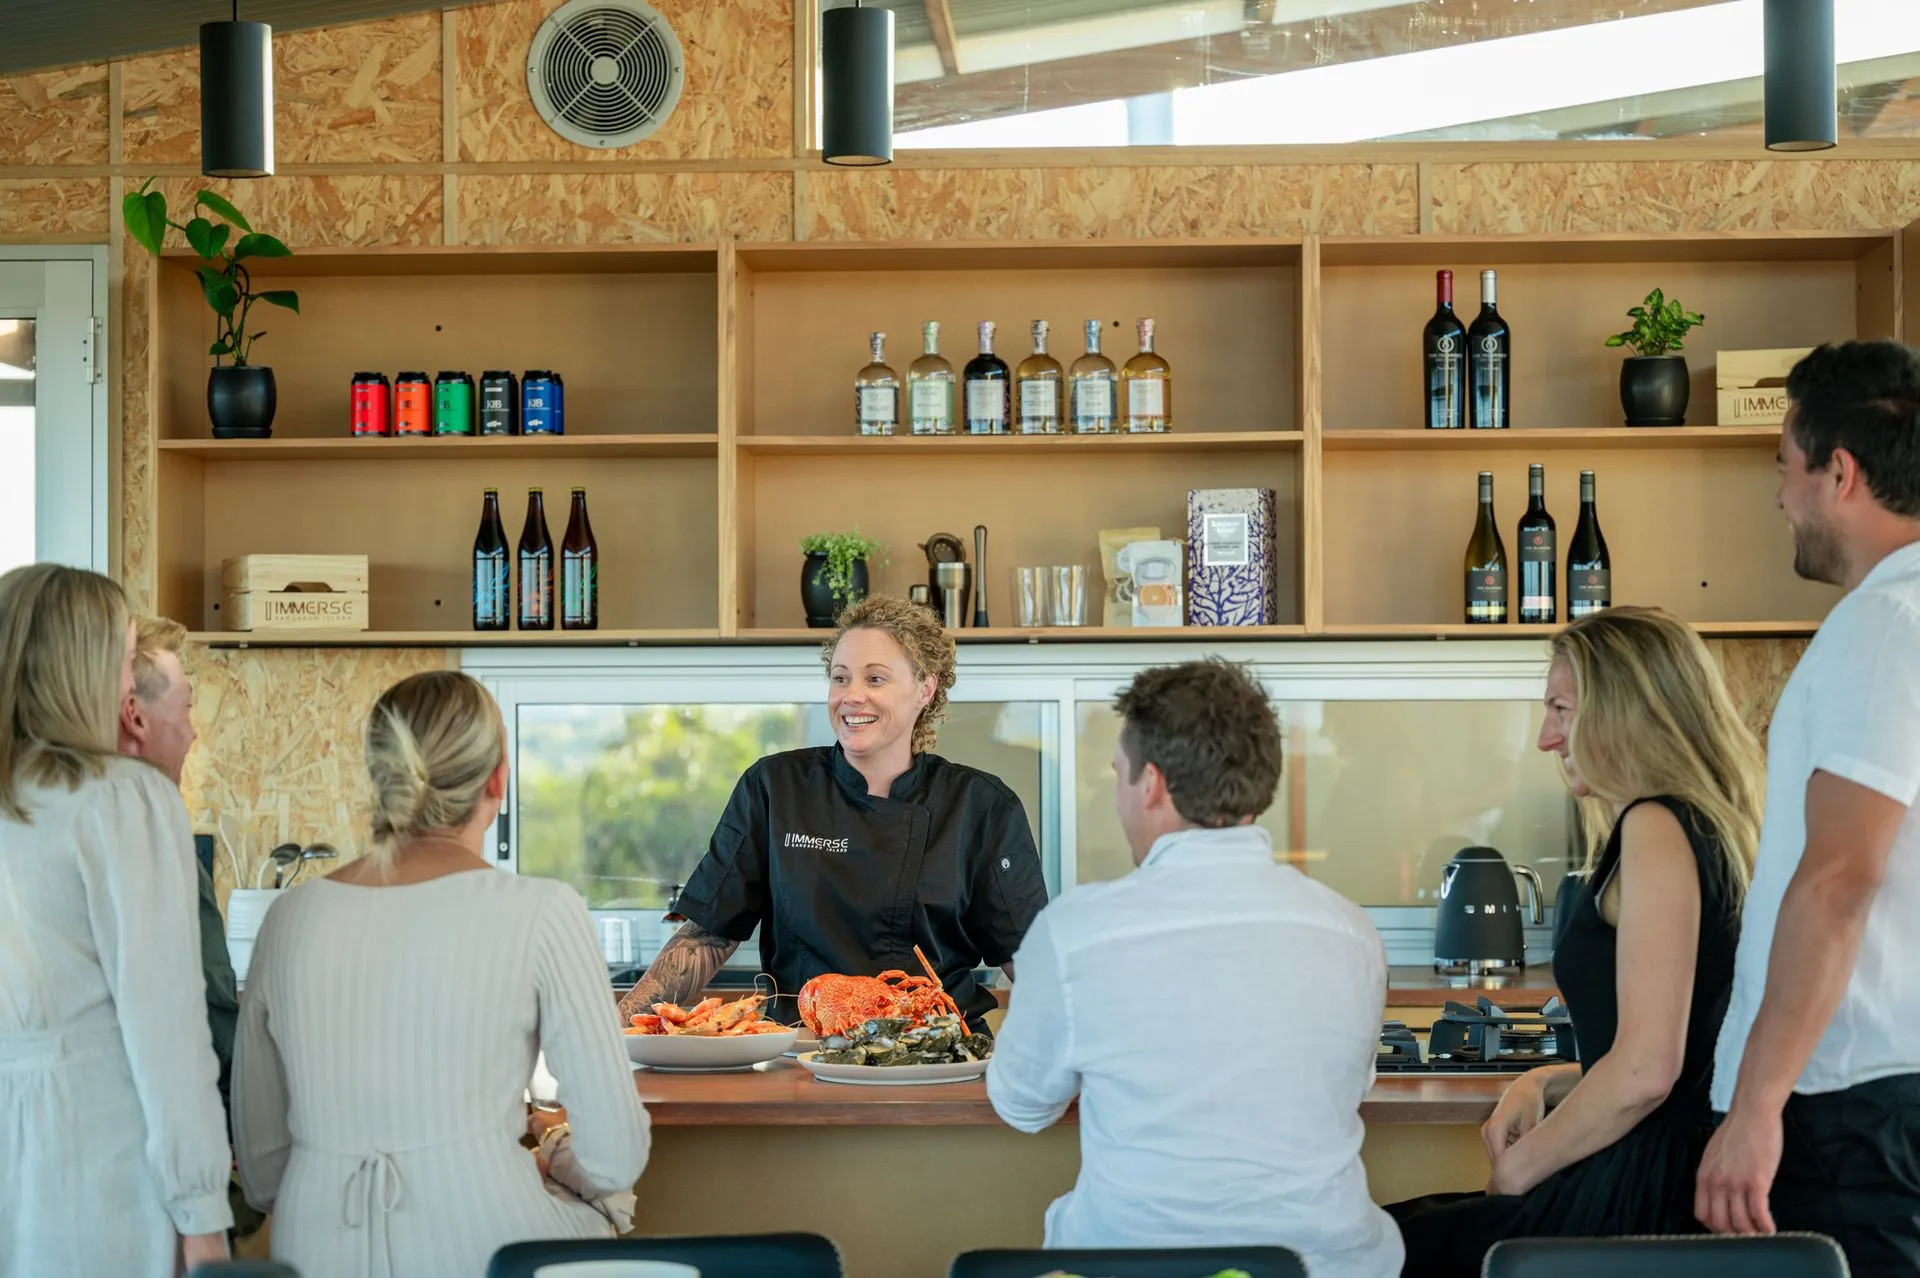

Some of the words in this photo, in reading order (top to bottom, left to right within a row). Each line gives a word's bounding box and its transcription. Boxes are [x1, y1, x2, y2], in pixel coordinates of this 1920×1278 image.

[1744, 396, 1790, 411] IMME
[275, 601, 353, 615] IMMERSE
[791, 833, 849, 848] IMMERSE
